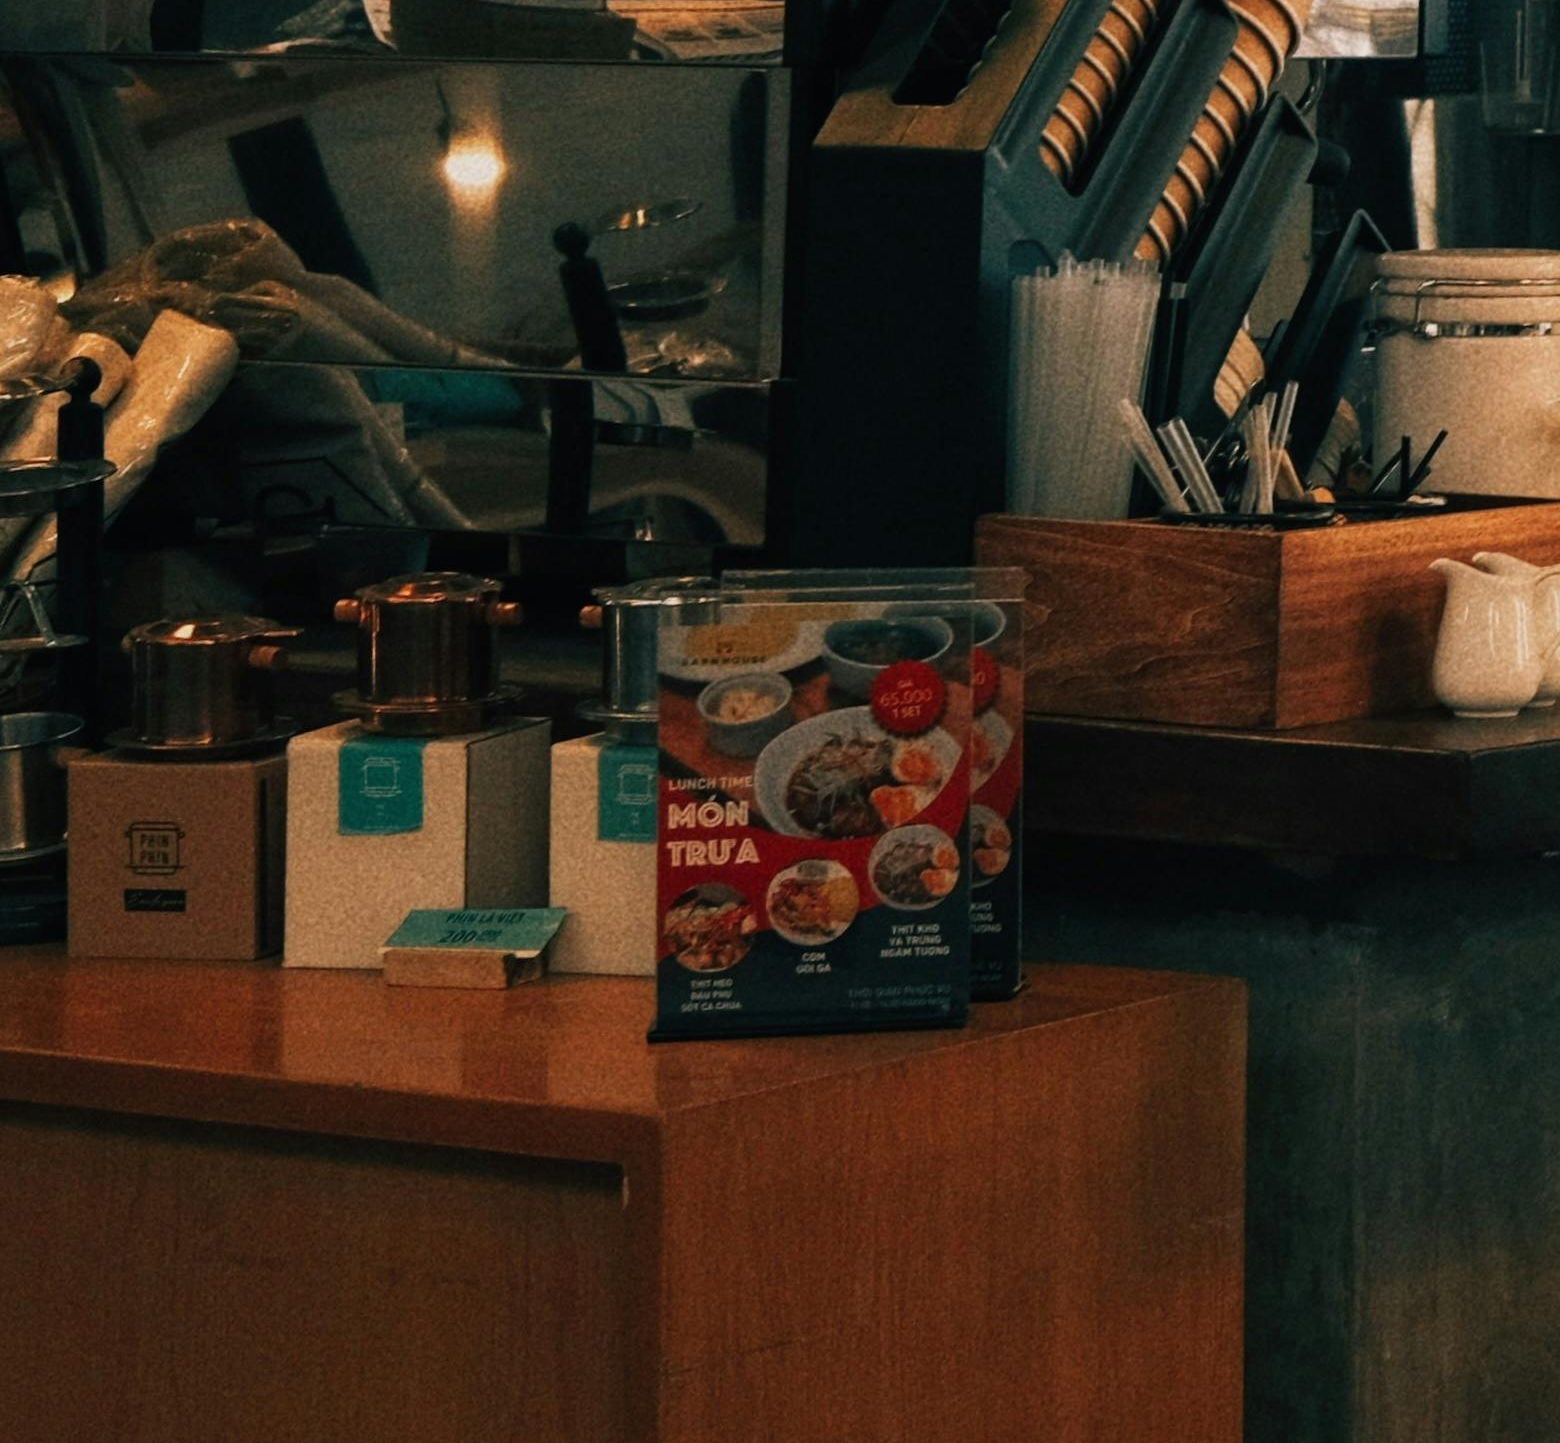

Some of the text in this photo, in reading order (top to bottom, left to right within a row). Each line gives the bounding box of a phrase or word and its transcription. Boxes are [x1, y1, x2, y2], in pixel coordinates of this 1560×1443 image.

[668, 775, 754, 791] LUNCH TIME
[667, 794, 749, 829] MÓN
